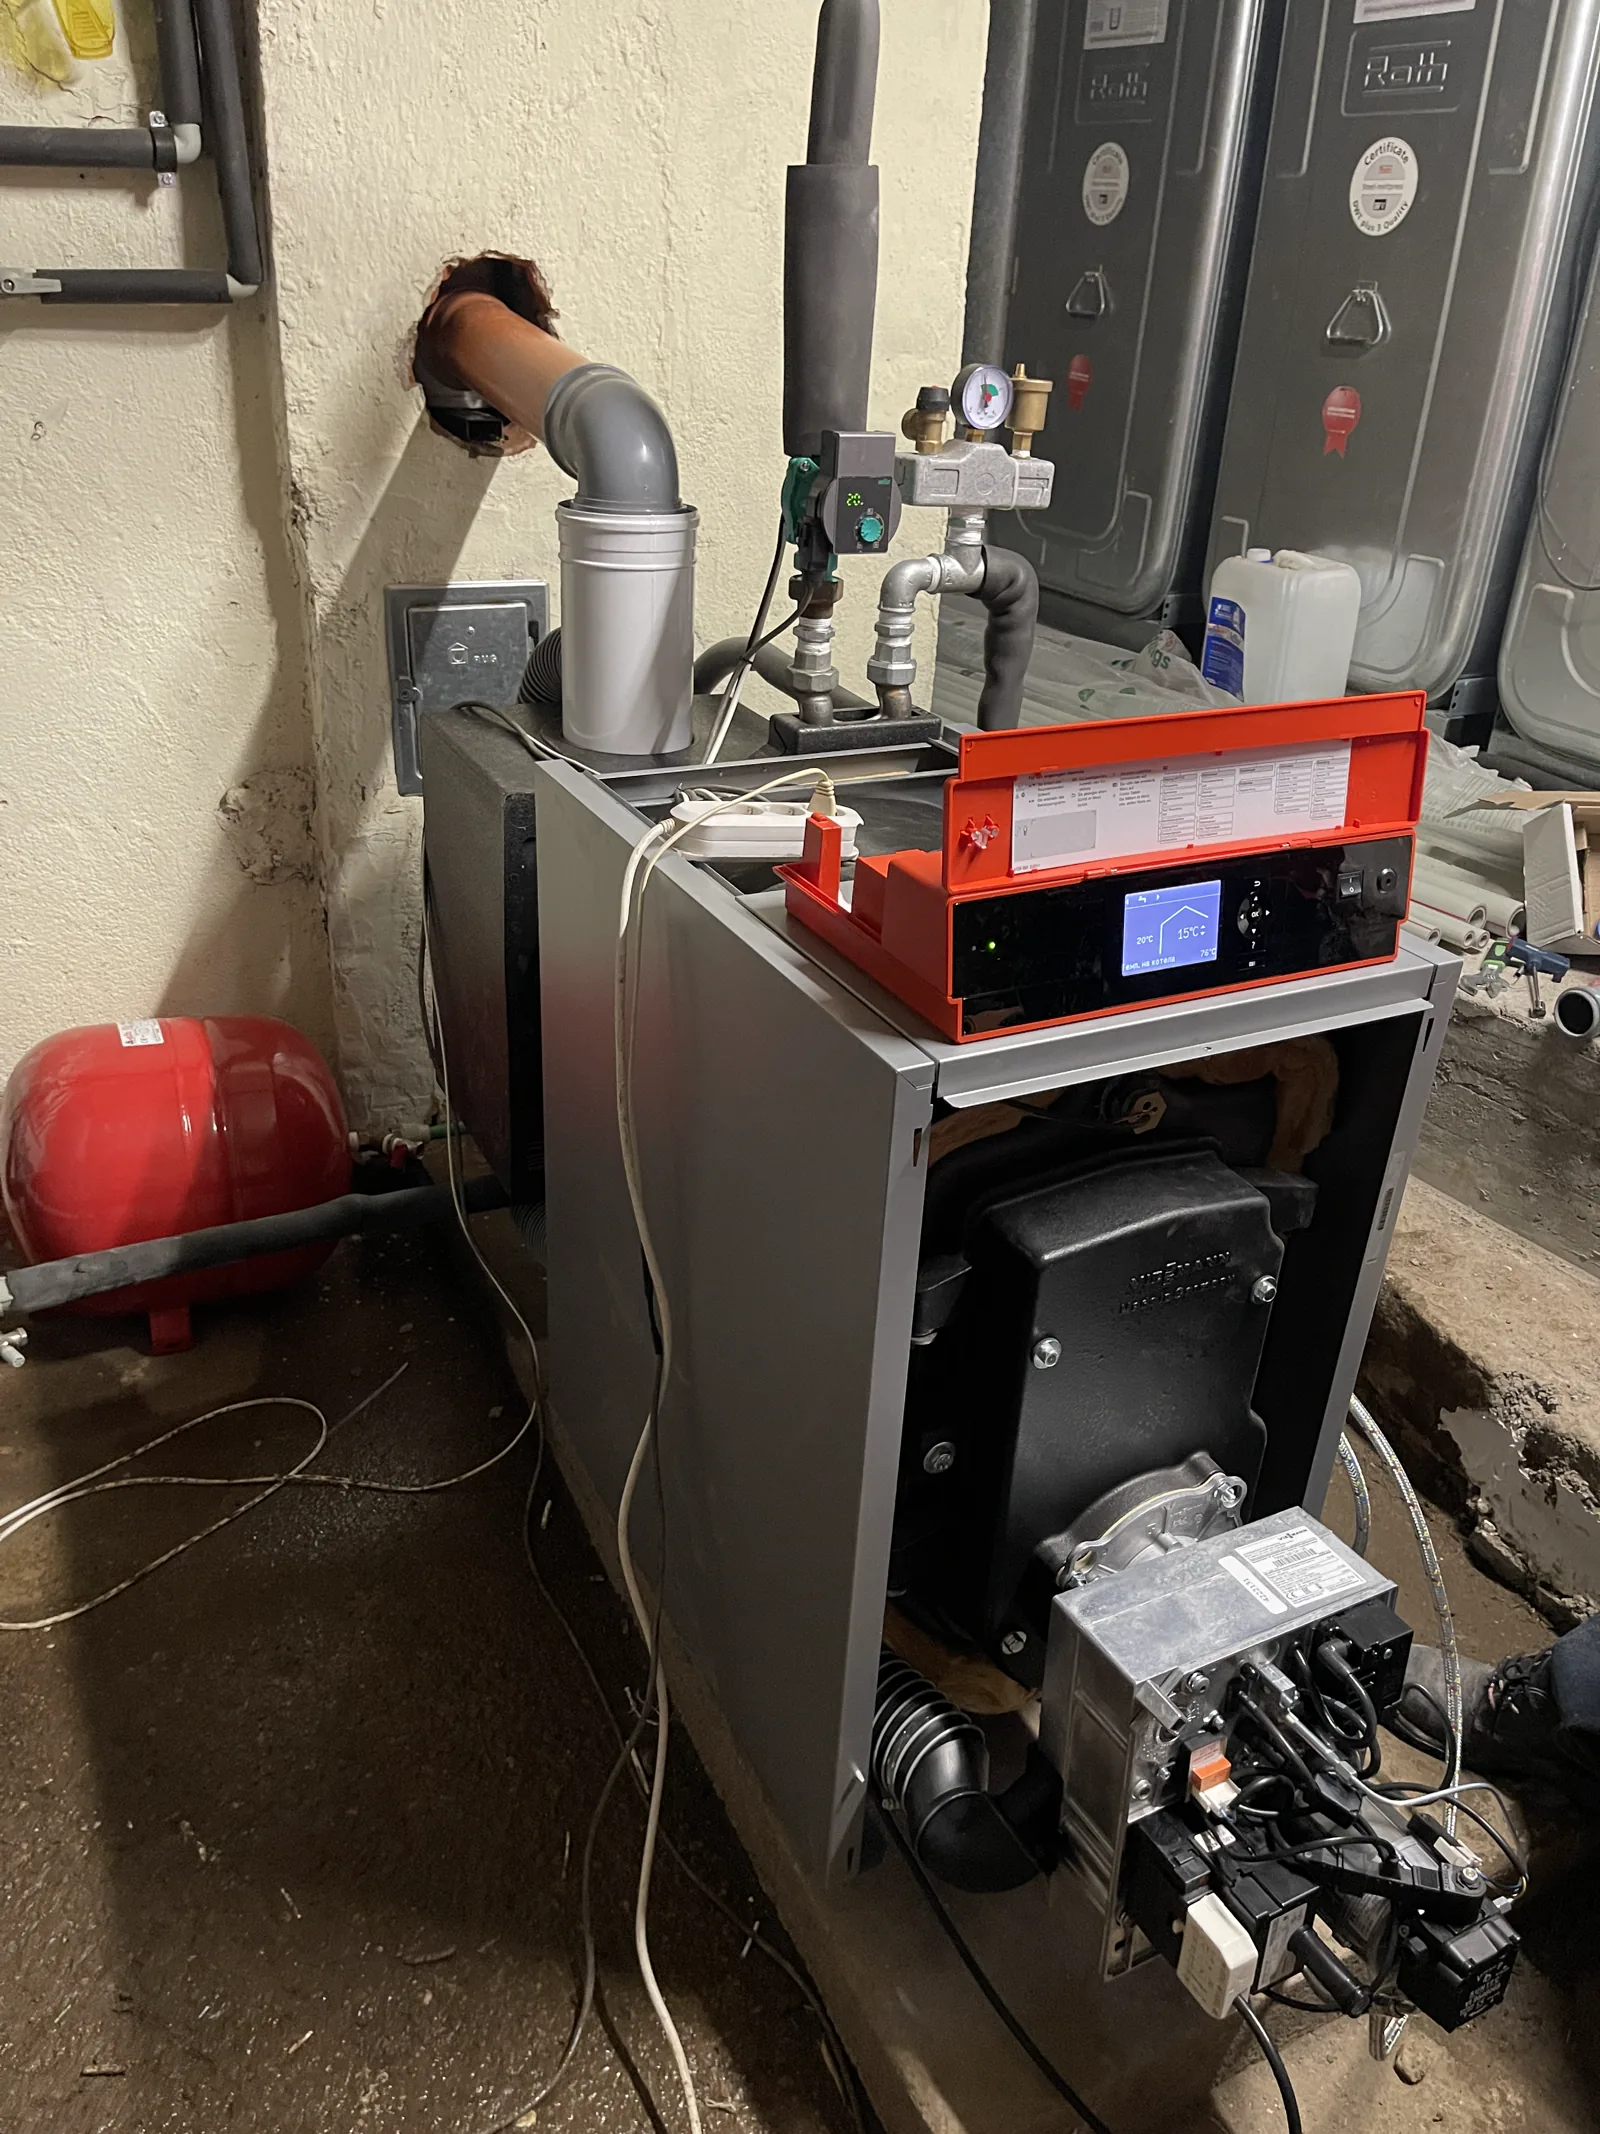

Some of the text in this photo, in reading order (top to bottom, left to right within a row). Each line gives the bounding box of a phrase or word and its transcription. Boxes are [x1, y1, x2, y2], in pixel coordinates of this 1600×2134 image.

[1363, 50, 1449, 88] Roth
[1363, 142, 1409, 165] Certificate
[1383, 201, 1409, 229] Quality
[1251, 910, 1260, 918] OK
[1136, 935, 1154, 945] 20°C
[1177, 925, 1199, 940] 15°C
[1200, 947, 1217, 957] 76°C
